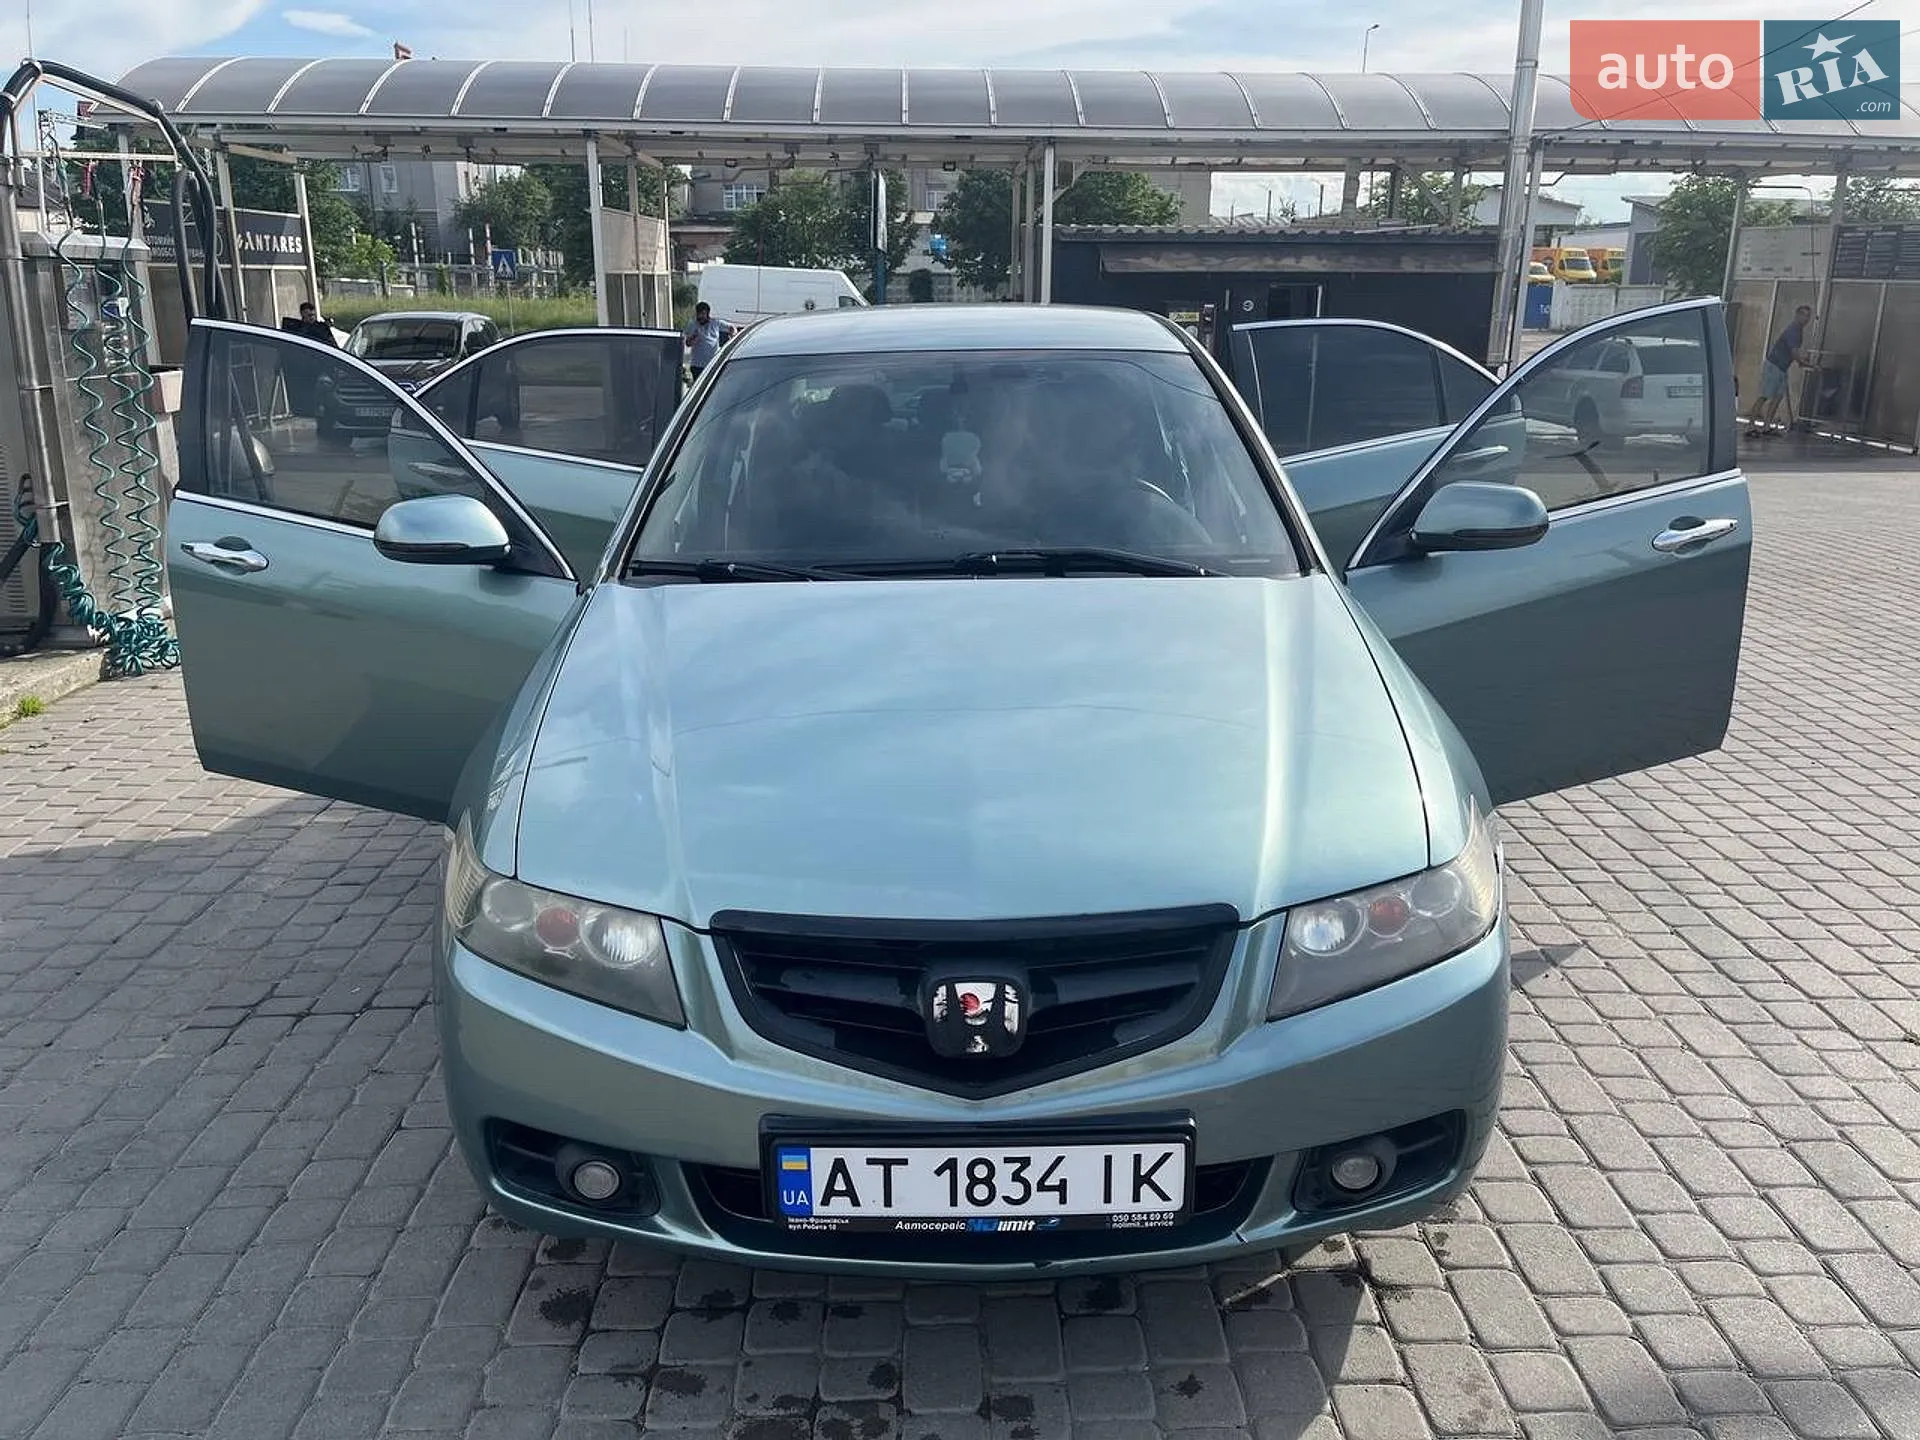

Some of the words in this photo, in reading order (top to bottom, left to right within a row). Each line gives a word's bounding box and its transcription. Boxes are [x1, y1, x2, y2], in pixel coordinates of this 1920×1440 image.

[783, 1190, 809, 1206] UA
[820, 1157, 909, 1208] AT
[933, 1155, 1068, 1207] 1834
[1103, 1152, 1174, 1204] IK
